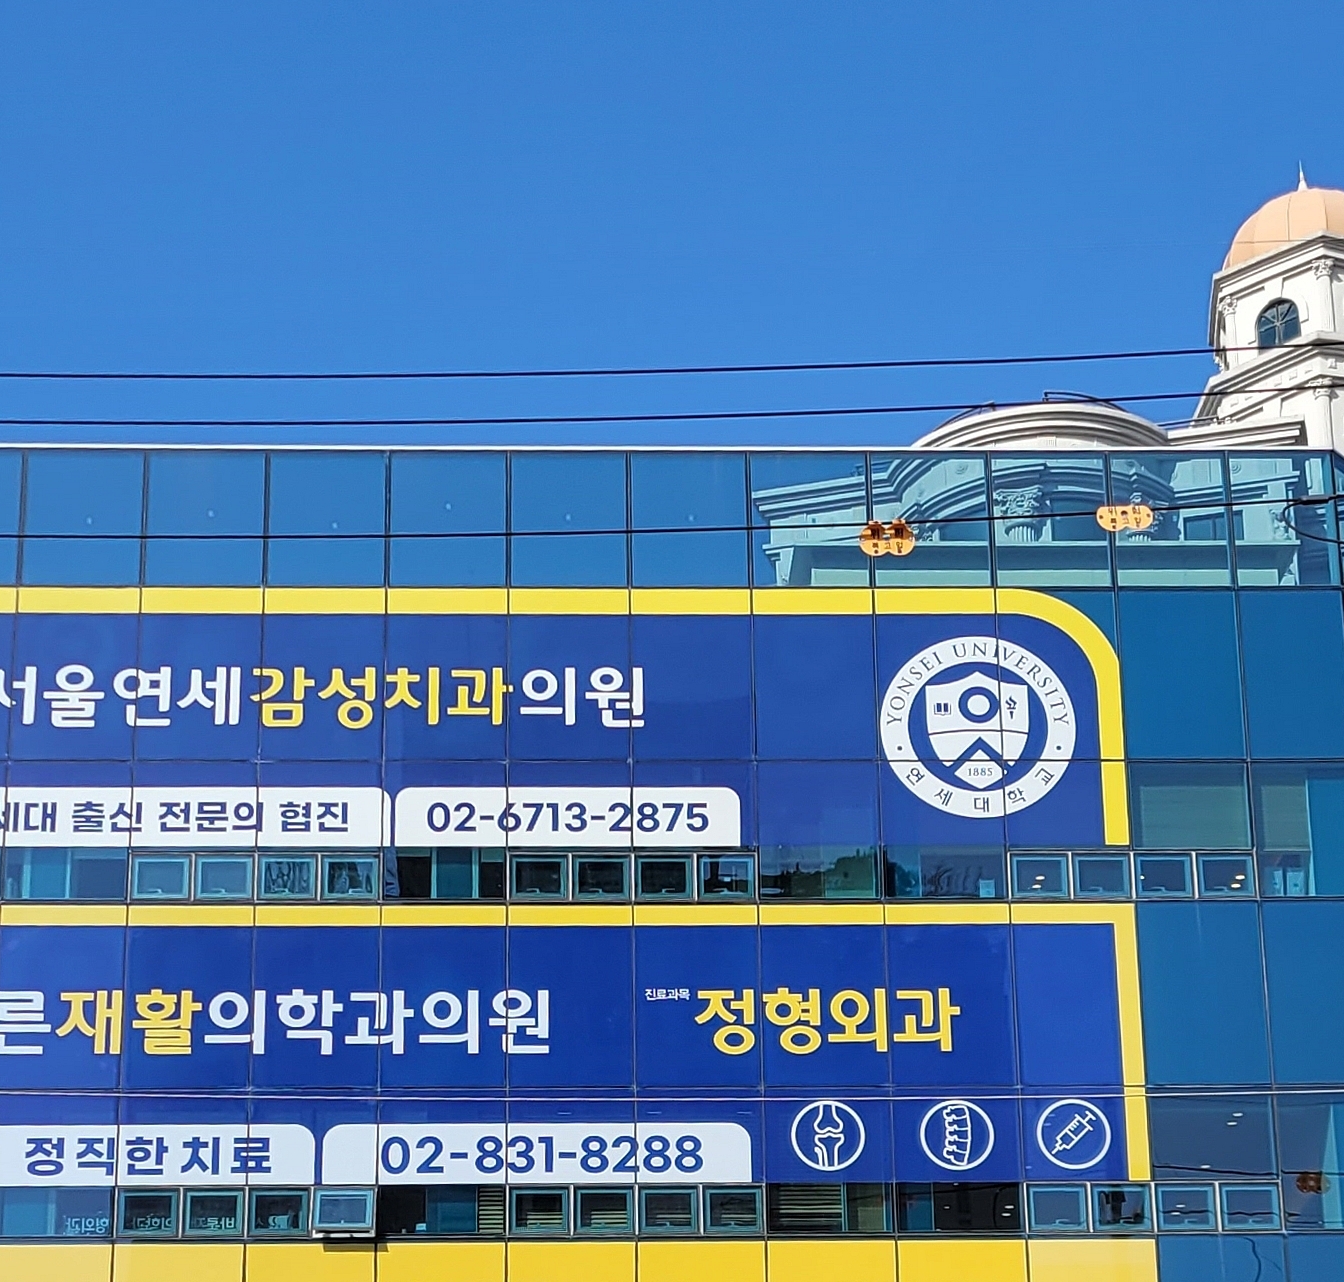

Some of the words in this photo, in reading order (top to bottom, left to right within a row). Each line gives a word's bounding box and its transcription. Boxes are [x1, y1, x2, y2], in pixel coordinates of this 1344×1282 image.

[886, 651, 943, 726] YONSEI
[952, 642, 1070, 726] UNIVERSITY
[906, 766, 1055, 813] 연세대학교
[967, 767, 993, 777] 1885
[71, 801, 143, 833] 출신
[157, 801, 263, 833] 전문의
[279, 801, 350, 833] 협진
[426, 801, 710, 834] 02-6713-2875
[644, 988, 692, 1001] 진료과목
[694, 987, 961, 1055] 정형외과
[380, 1136, 703, 1175] 02-831-8288
